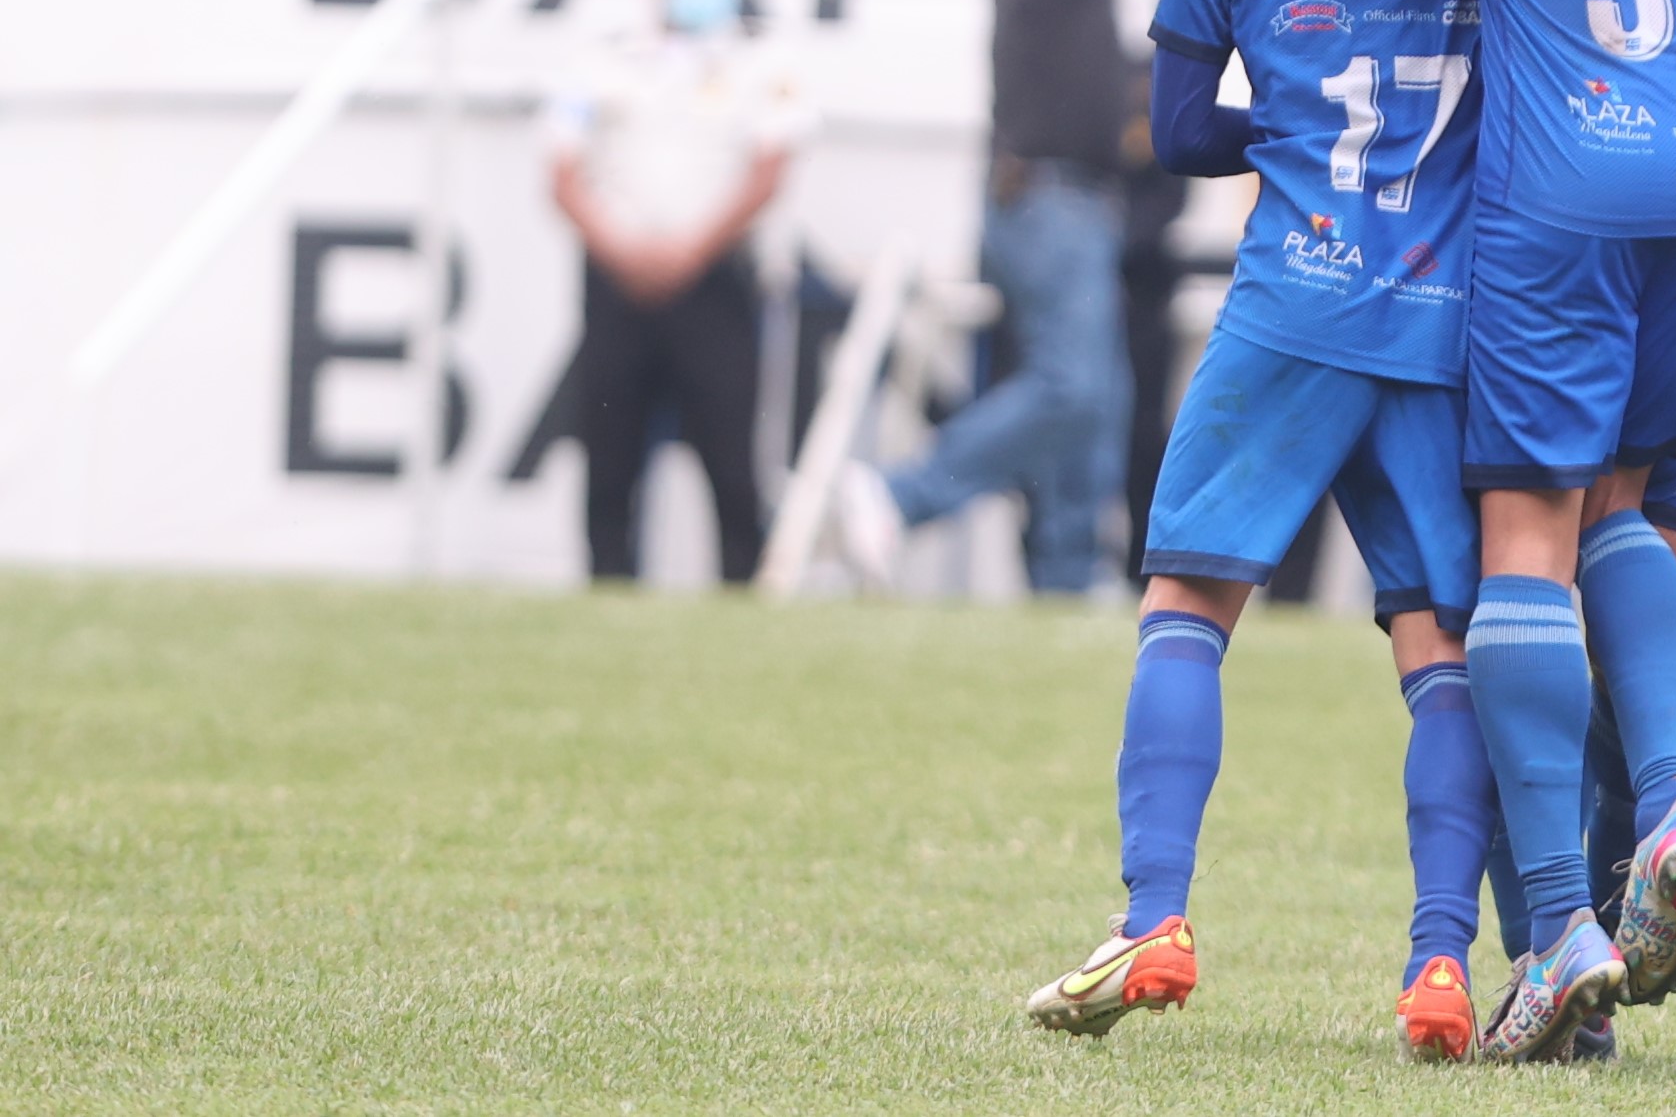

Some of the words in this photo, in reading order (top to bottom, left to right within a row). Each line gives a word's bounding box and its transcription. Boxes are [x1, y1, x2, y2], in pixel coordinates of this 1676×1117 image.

[1567, 94, 1656, 126] PLAZA
[1321, 54, 1472, 213] 17
[1283, 230, 1363, 268] PLAZA
